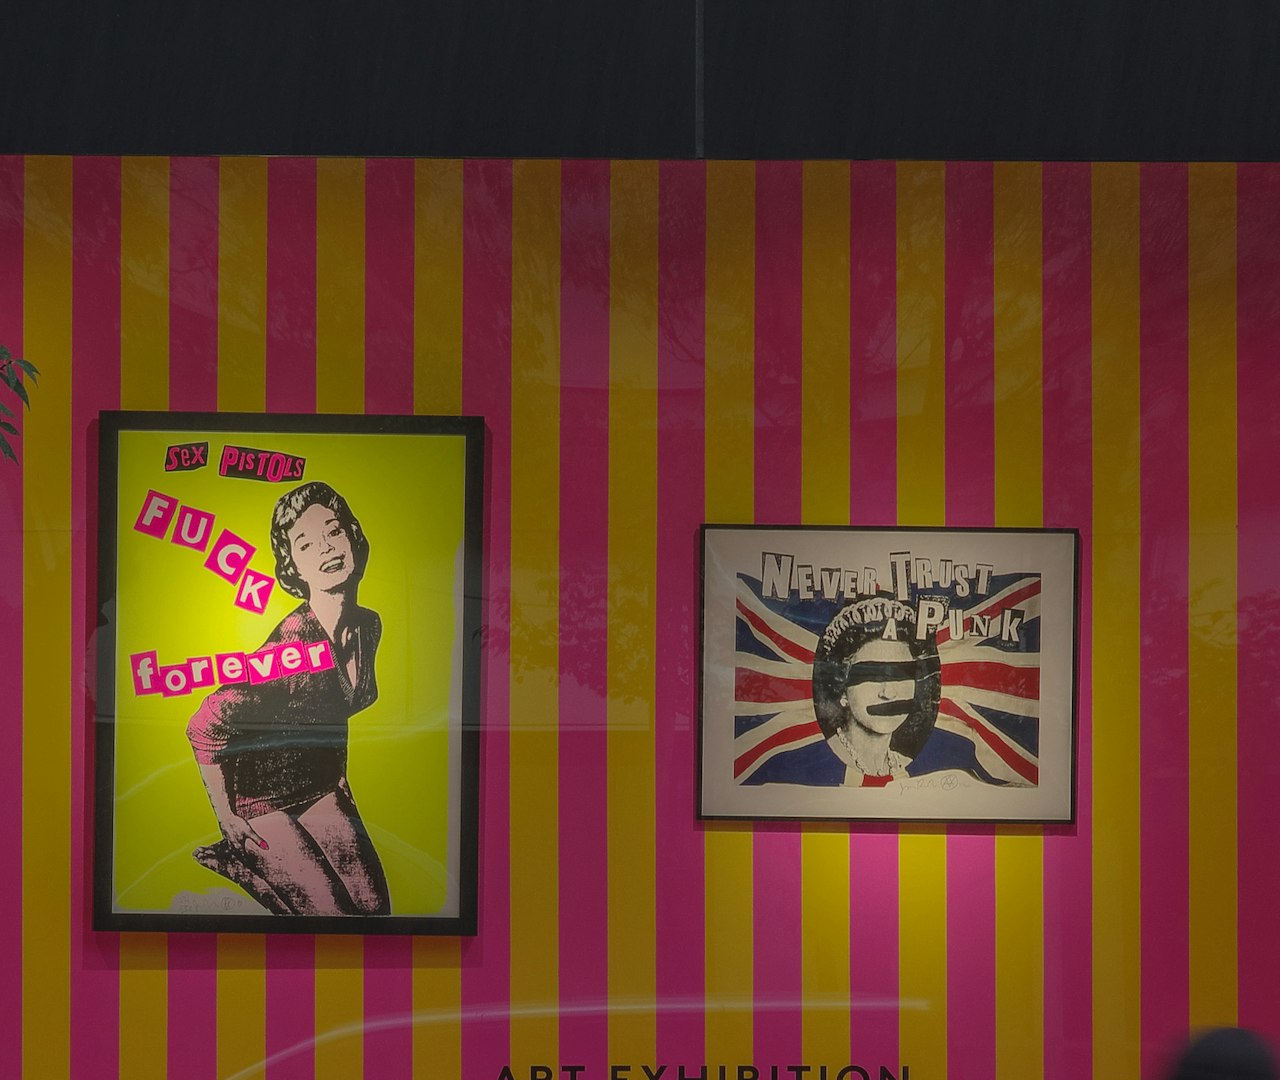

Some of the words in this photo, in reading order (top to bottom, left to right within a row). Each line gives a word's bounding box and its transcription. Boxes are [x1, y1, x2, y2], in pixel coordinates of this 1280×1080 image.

[140, 494, 270, 610] FUCK
[762, 552, 878, 601] NEVER
[890, 551, 994, 601] TRUST
[882, 618, 898, 641] A
[916, 598, 1024, 642] PUNK
[135, 643, 327, 694] forever
